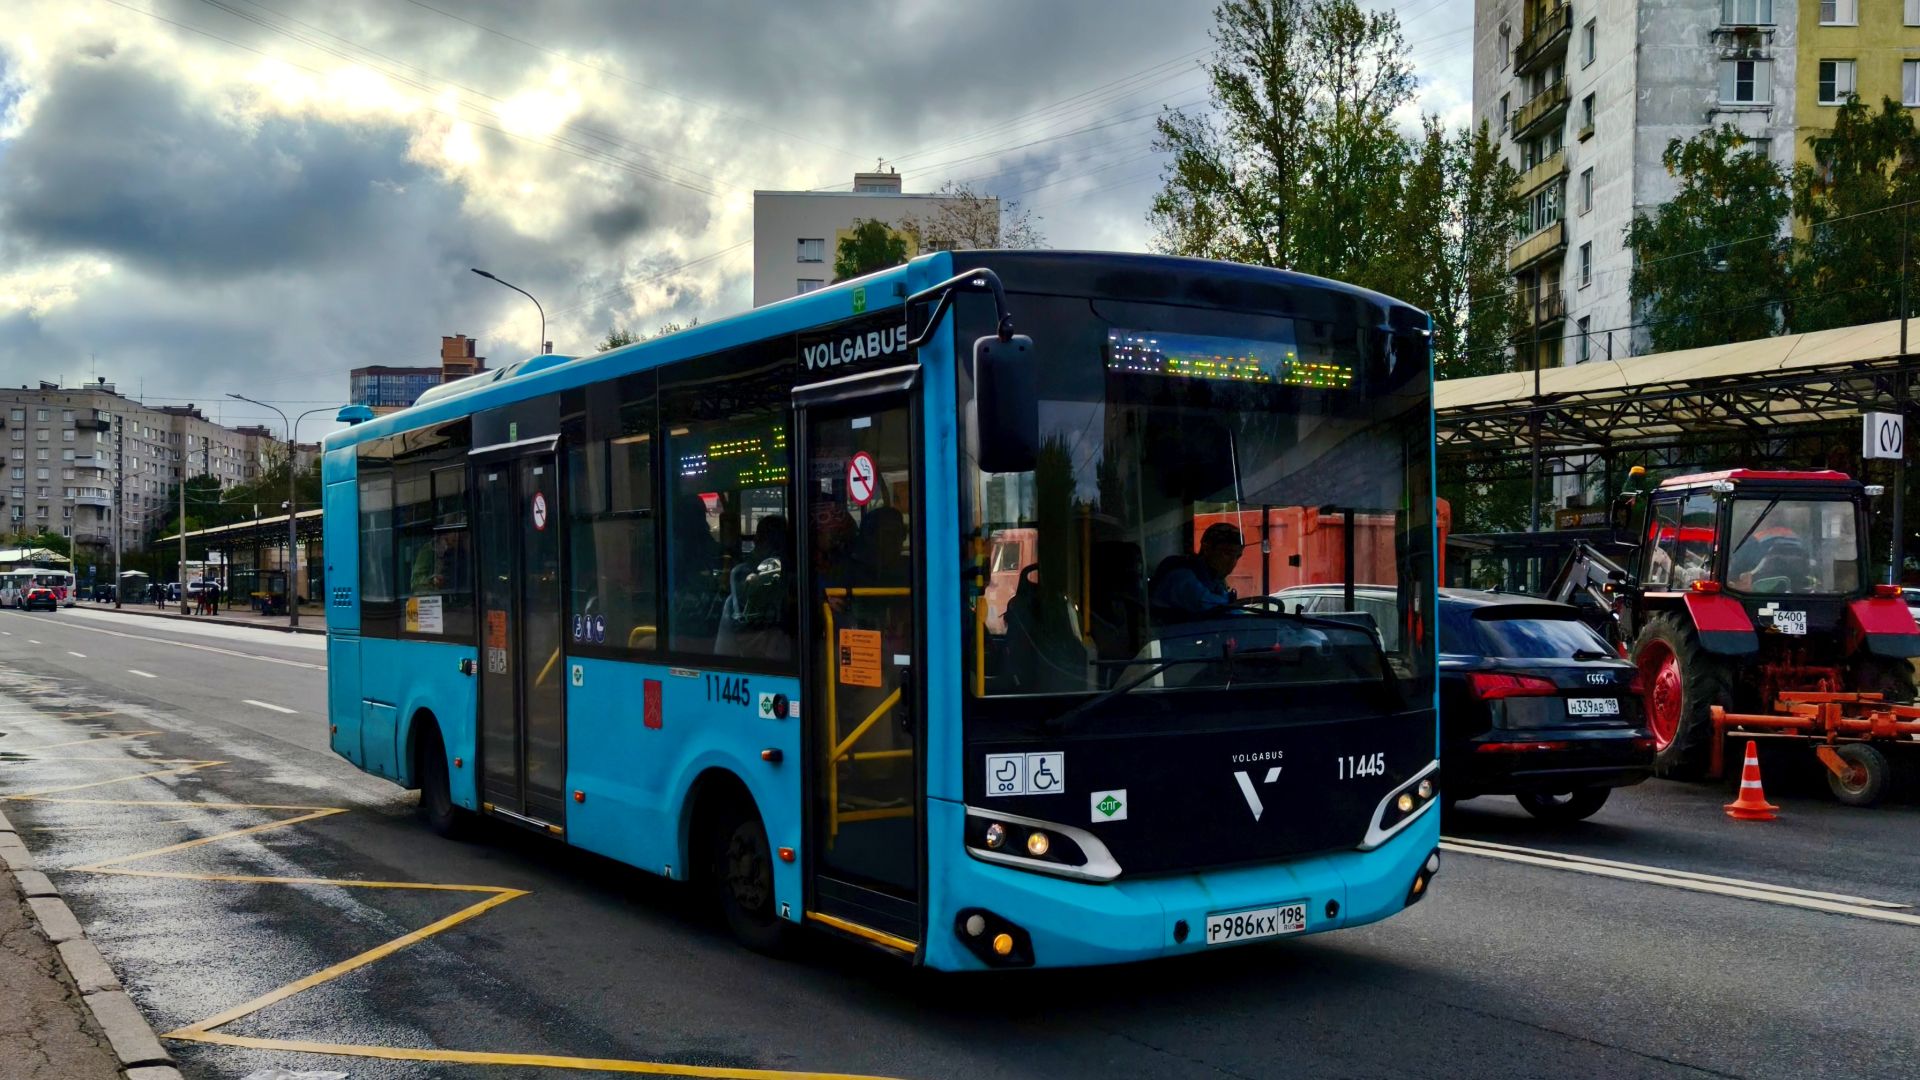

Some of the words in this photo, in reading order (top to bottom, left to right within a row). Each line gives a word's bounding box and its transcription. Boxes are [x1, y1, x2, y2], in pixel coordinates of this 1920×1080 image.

[803, 323, 907, 370] VOLGABUS
[1777, 612, 1802, 622] 6400
[706, 674, 750, 706] 11445
[1232, 751, 1283, 763] VOLGABUS
[1338, 752, 1385, 780] 11445
[1101, 801, 1118, 811] СПГ
[1212, 914, 1276, 941] Р986КХ
[1280, 906, 1302, 924] 198
